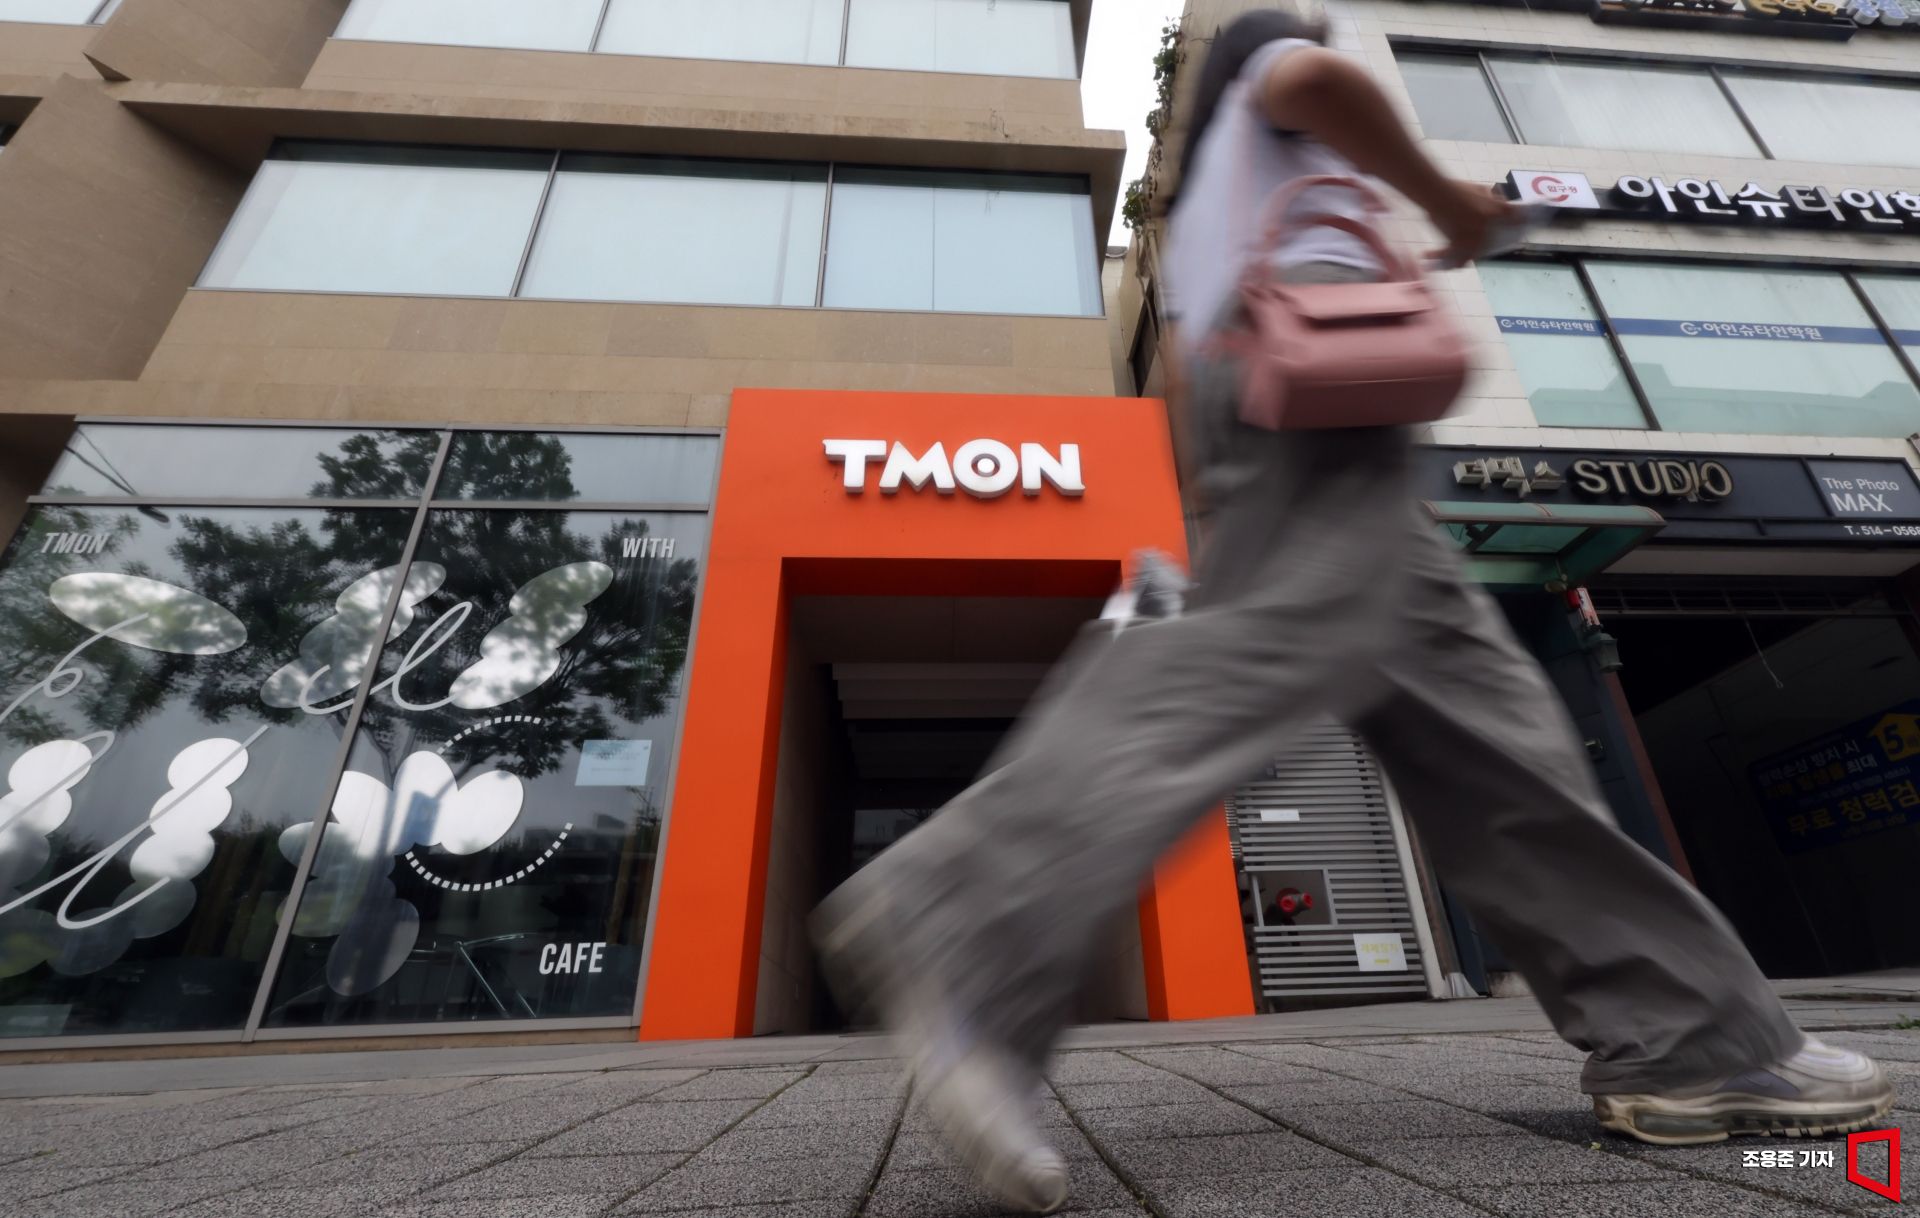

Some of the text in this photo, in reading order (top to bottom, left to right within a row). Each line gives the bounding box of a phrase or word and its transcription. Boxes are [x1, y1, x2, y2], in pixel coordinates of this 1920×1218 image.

[1516, 319, 1596, 332] 아인슈타인학원
[1704, 322, 1824, 340] 아인슈타인학원
[822, 438, 1086, 498] TMON
[1572, 459, 1735, 499] STUDIO
[1823, 477, 1900, 491] The Photo
[1830, 493, 1893, 512] MAX
[40, 532, 109, 555] TMON
[622, 537, 675, 559] WITH
[1787, 807, 1837, 836] 무료
[539, 942, 606, 976] CAFE
